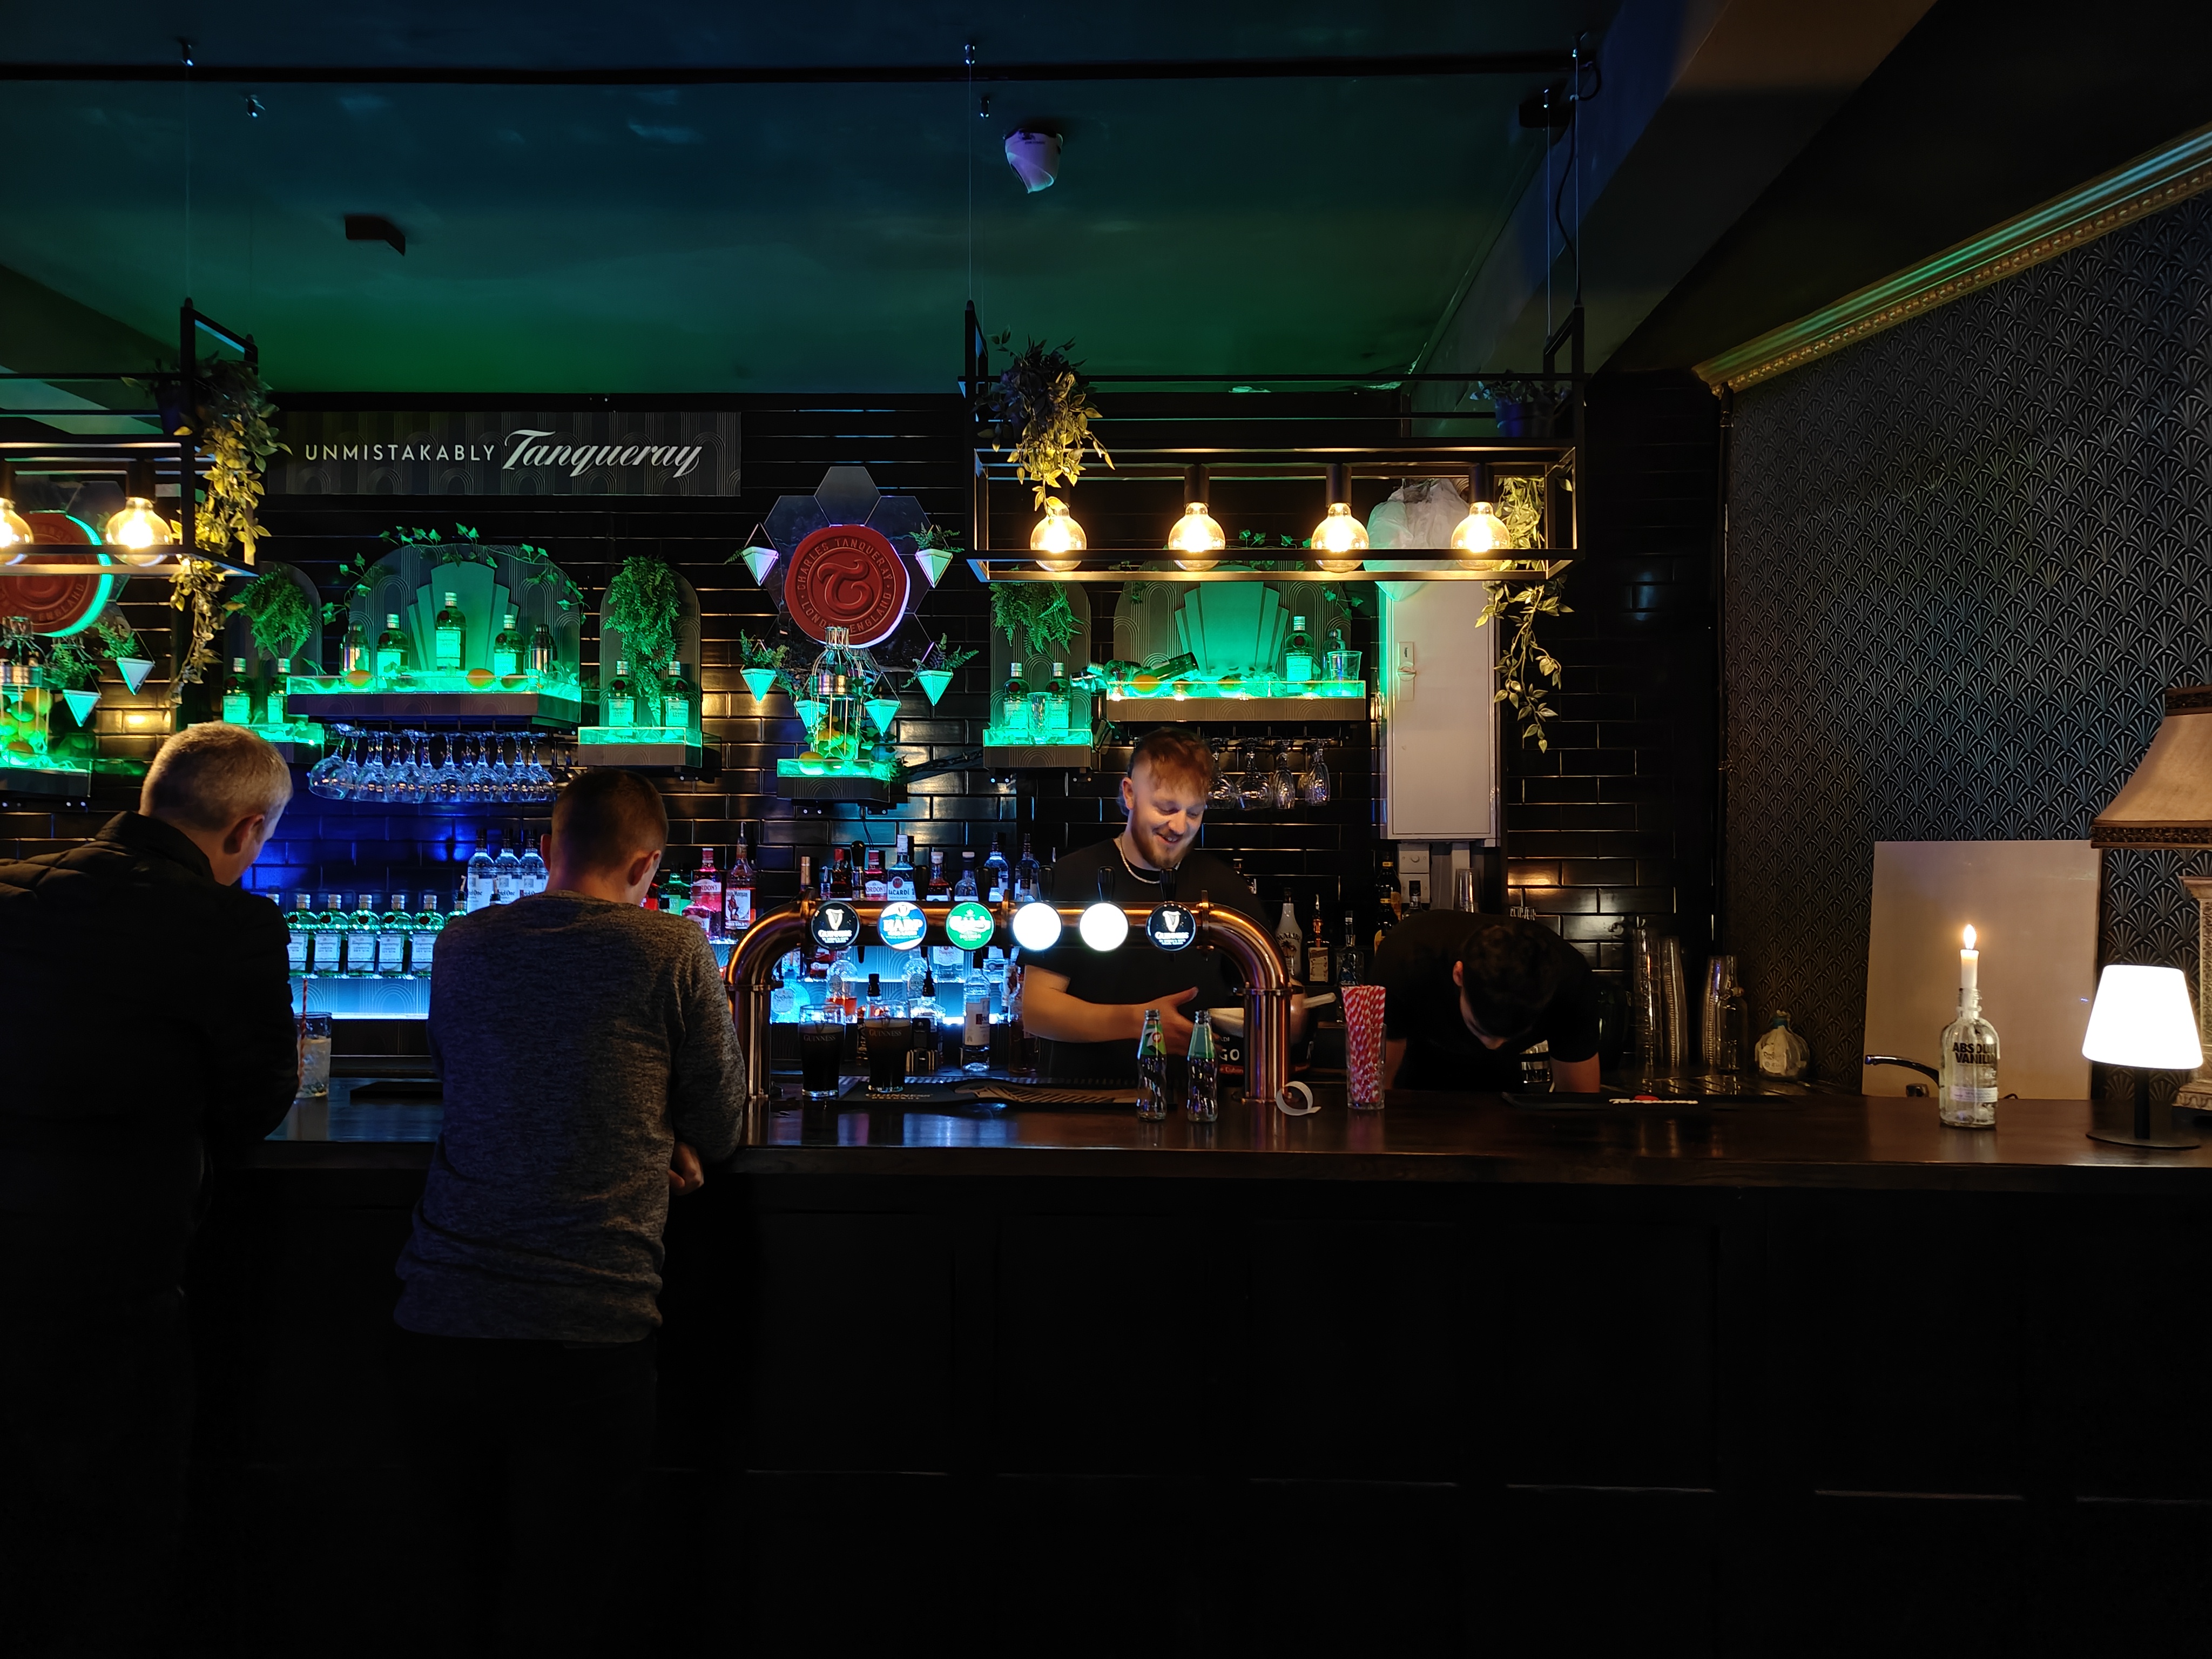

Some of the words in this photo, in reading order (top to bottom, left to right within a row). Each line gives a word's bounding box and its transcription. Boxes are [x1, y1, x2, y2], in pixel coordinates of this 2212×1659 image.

[305, 444, 495, 461] UNMISTAKABLY
[502, 429, 703, 478] Tanqueray
[797, 543, 829, 590] CHARLES
[834, 538, 893, 581] TANQUERAY
[801, 601, 844, 628] LOND
[850, 592, 892, 633] ENGLAND
[883, 919, 923, 931] HARP
[818, 929, 852, 938] GUINNESS
[803, 1034, 836, 1042] GUINNESS
[868, 1029, 902, 1037] GUINNESS
